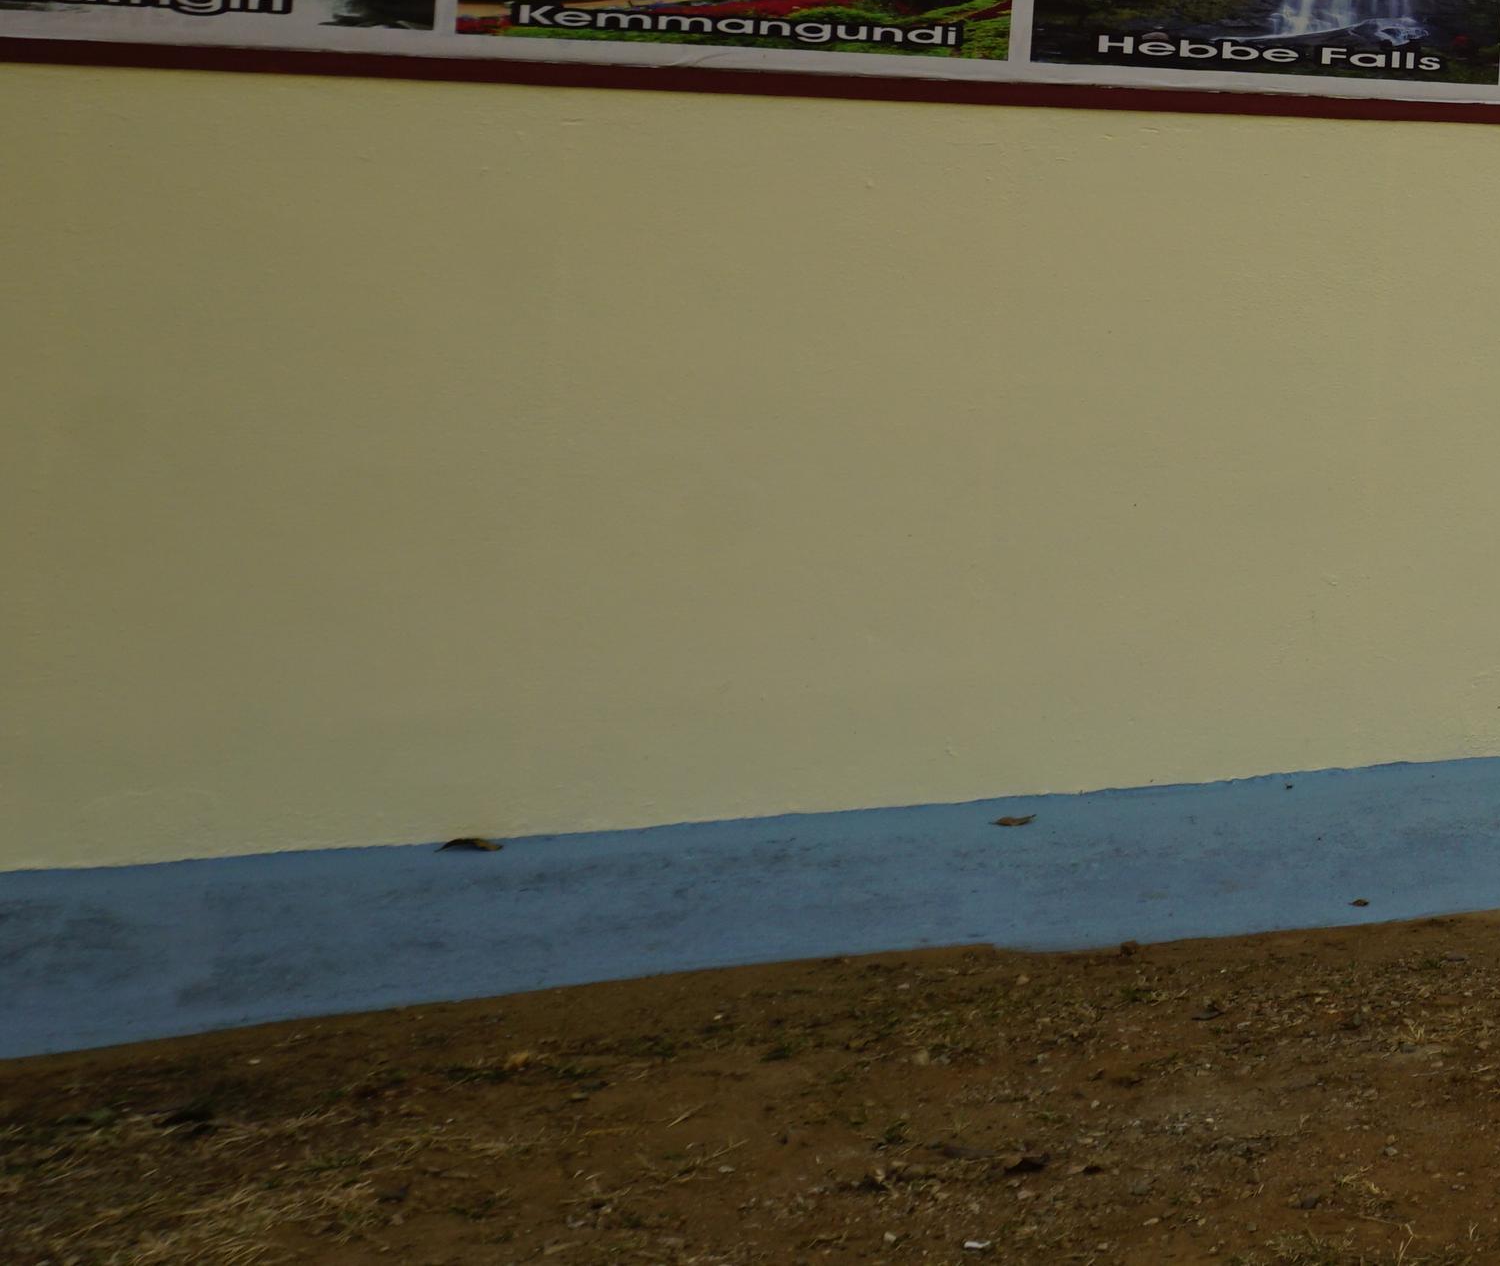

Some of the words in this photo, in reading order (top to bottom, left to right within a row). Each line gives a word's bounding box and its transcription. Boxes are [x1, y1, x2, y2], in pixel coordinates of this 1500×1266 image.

[518, 4, 958, 45] Kemmangundi
[1097, 35, 1300, 64] Hebbe
[1320, 47, 1442, 72] Falls
